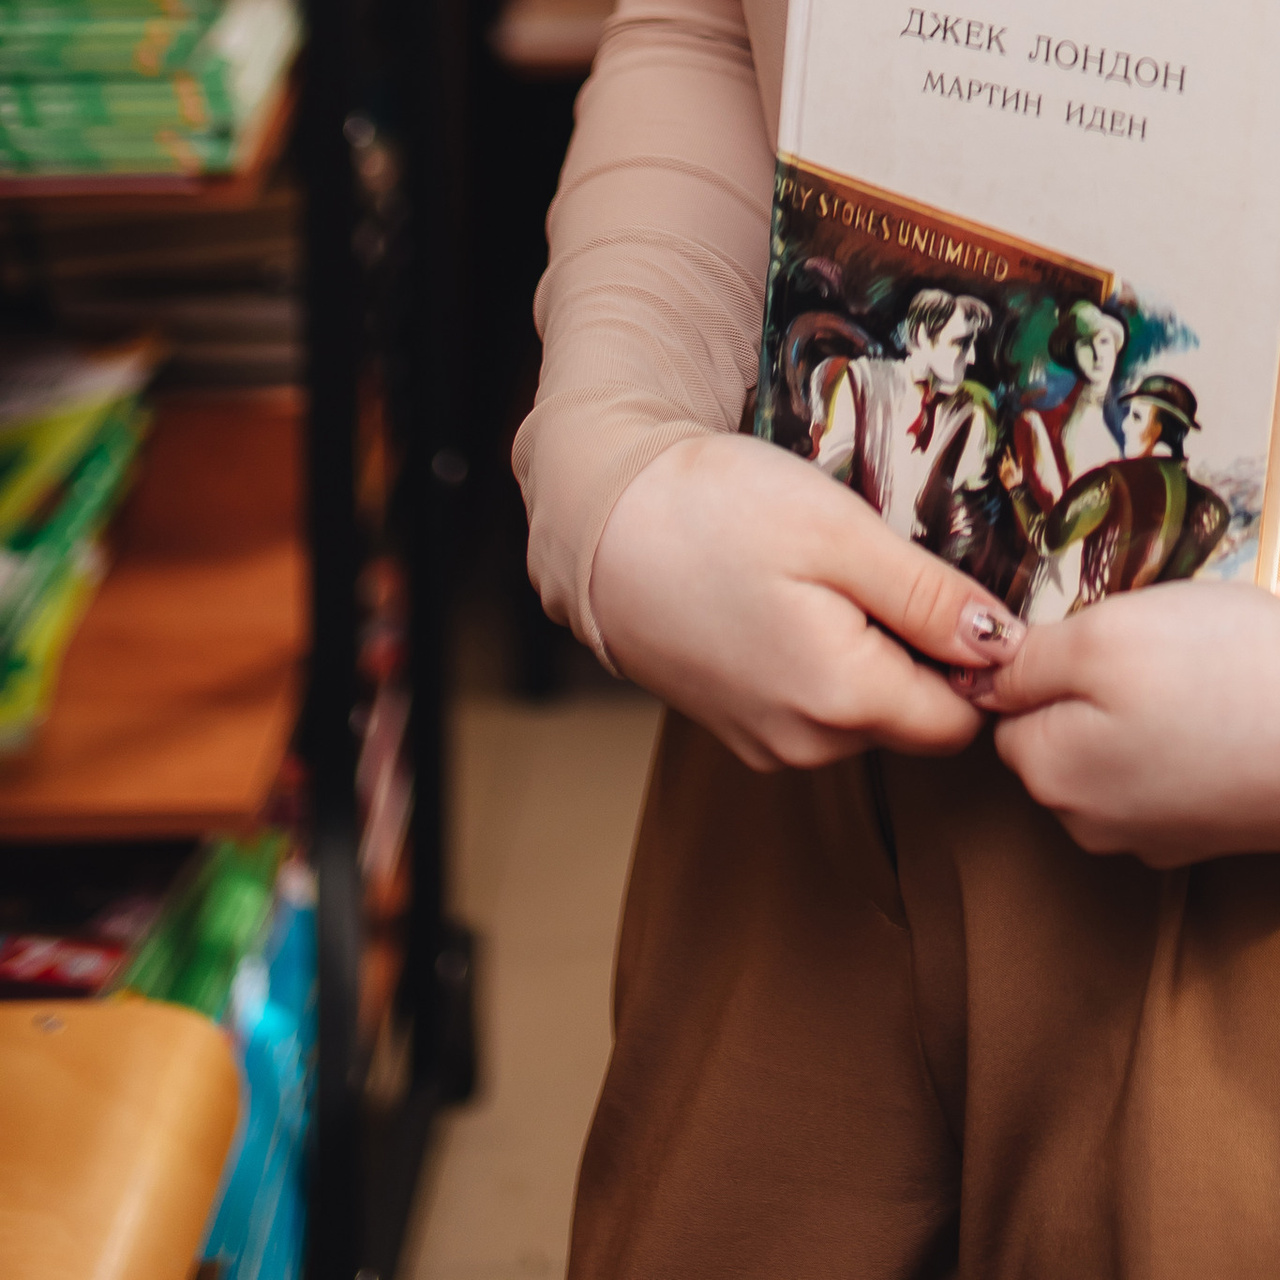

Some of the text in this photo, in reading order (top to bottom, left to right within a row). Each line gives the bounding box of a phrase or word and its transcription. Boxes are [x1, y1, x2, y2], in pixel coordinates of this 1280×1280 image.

[900, 7, 1187, 94] ДЖЕК ЛОНДОН
[922, 70, 1148, 142] МАРТИН ИДЕН
[898, 219, 1010, 283] UNLIMITED
